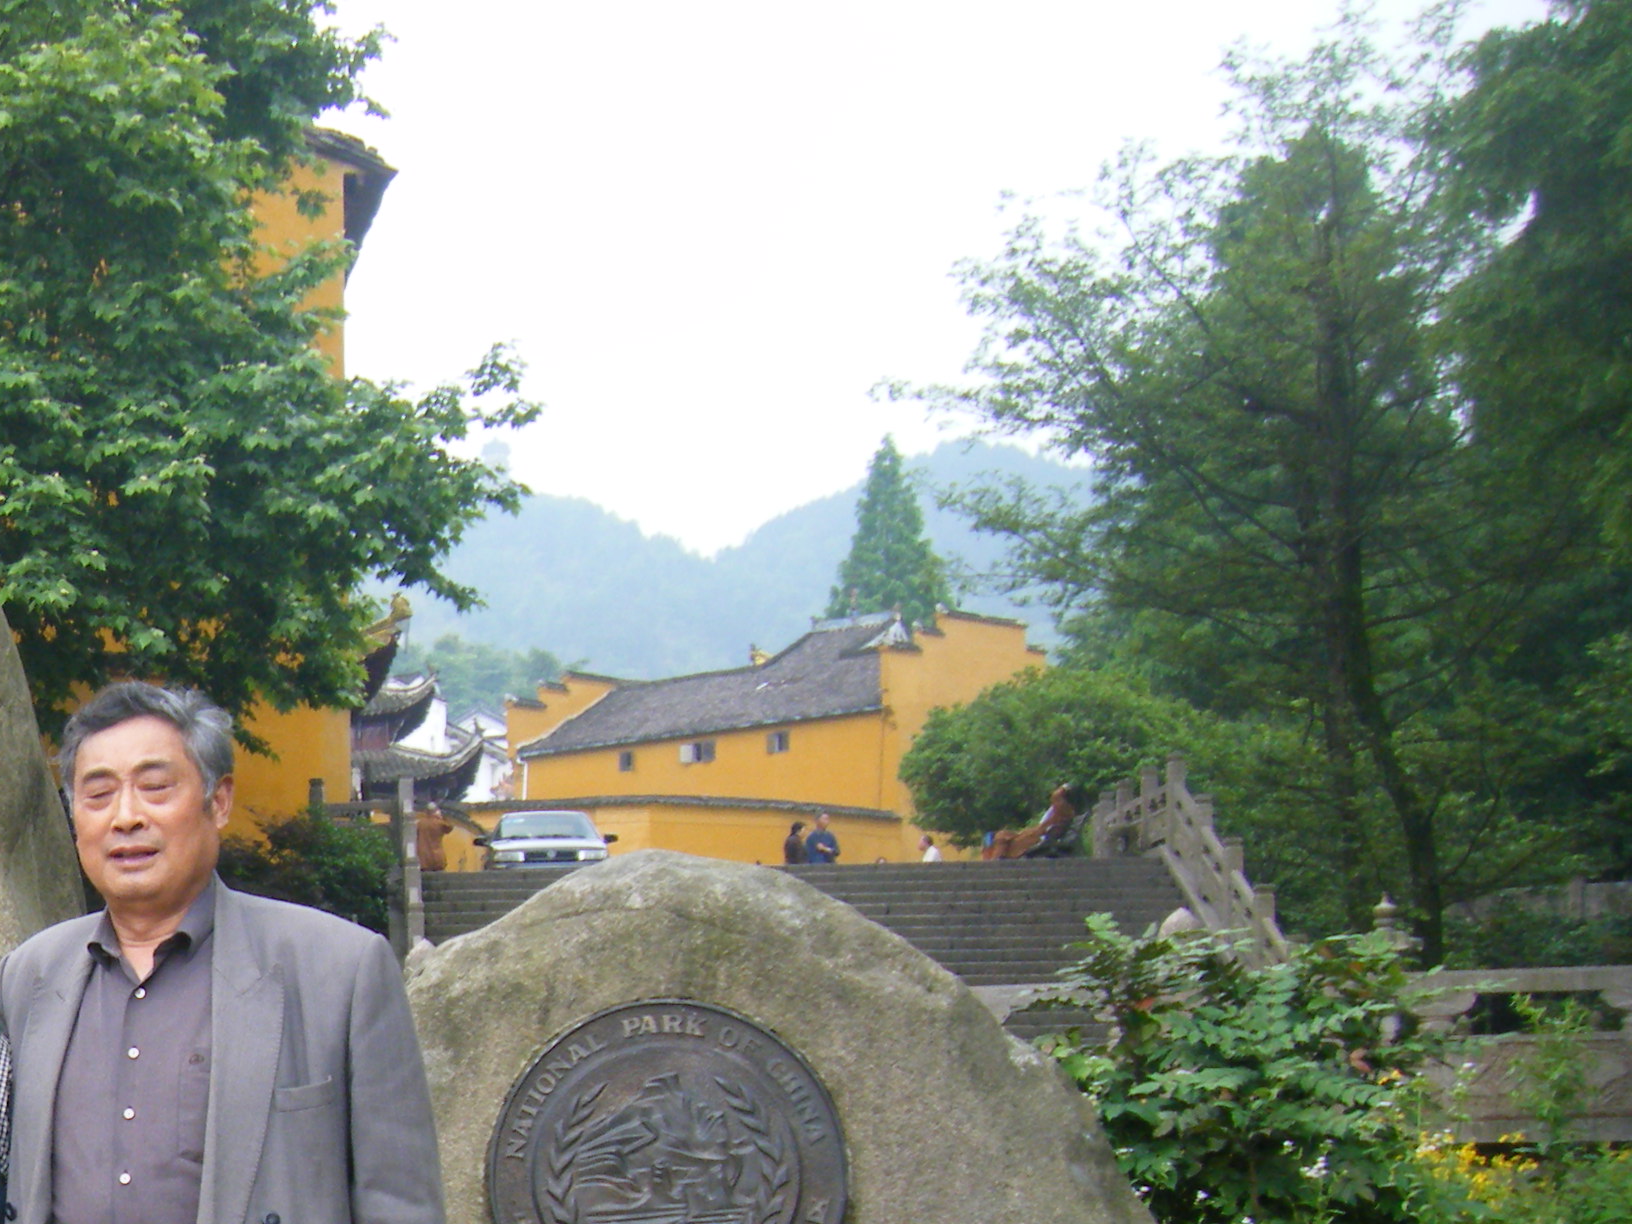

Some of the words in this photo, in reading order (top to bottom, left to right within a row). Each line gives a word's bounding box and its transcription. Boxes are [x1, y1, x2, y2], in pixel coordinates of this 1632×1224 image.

[505, 1034, 608, 1160] NATIONAL
[622, 1014, 707, 1038] PARK
[719, 1026, 764, 1052] OF
[767, 1058, 826, 1146] CHINA
